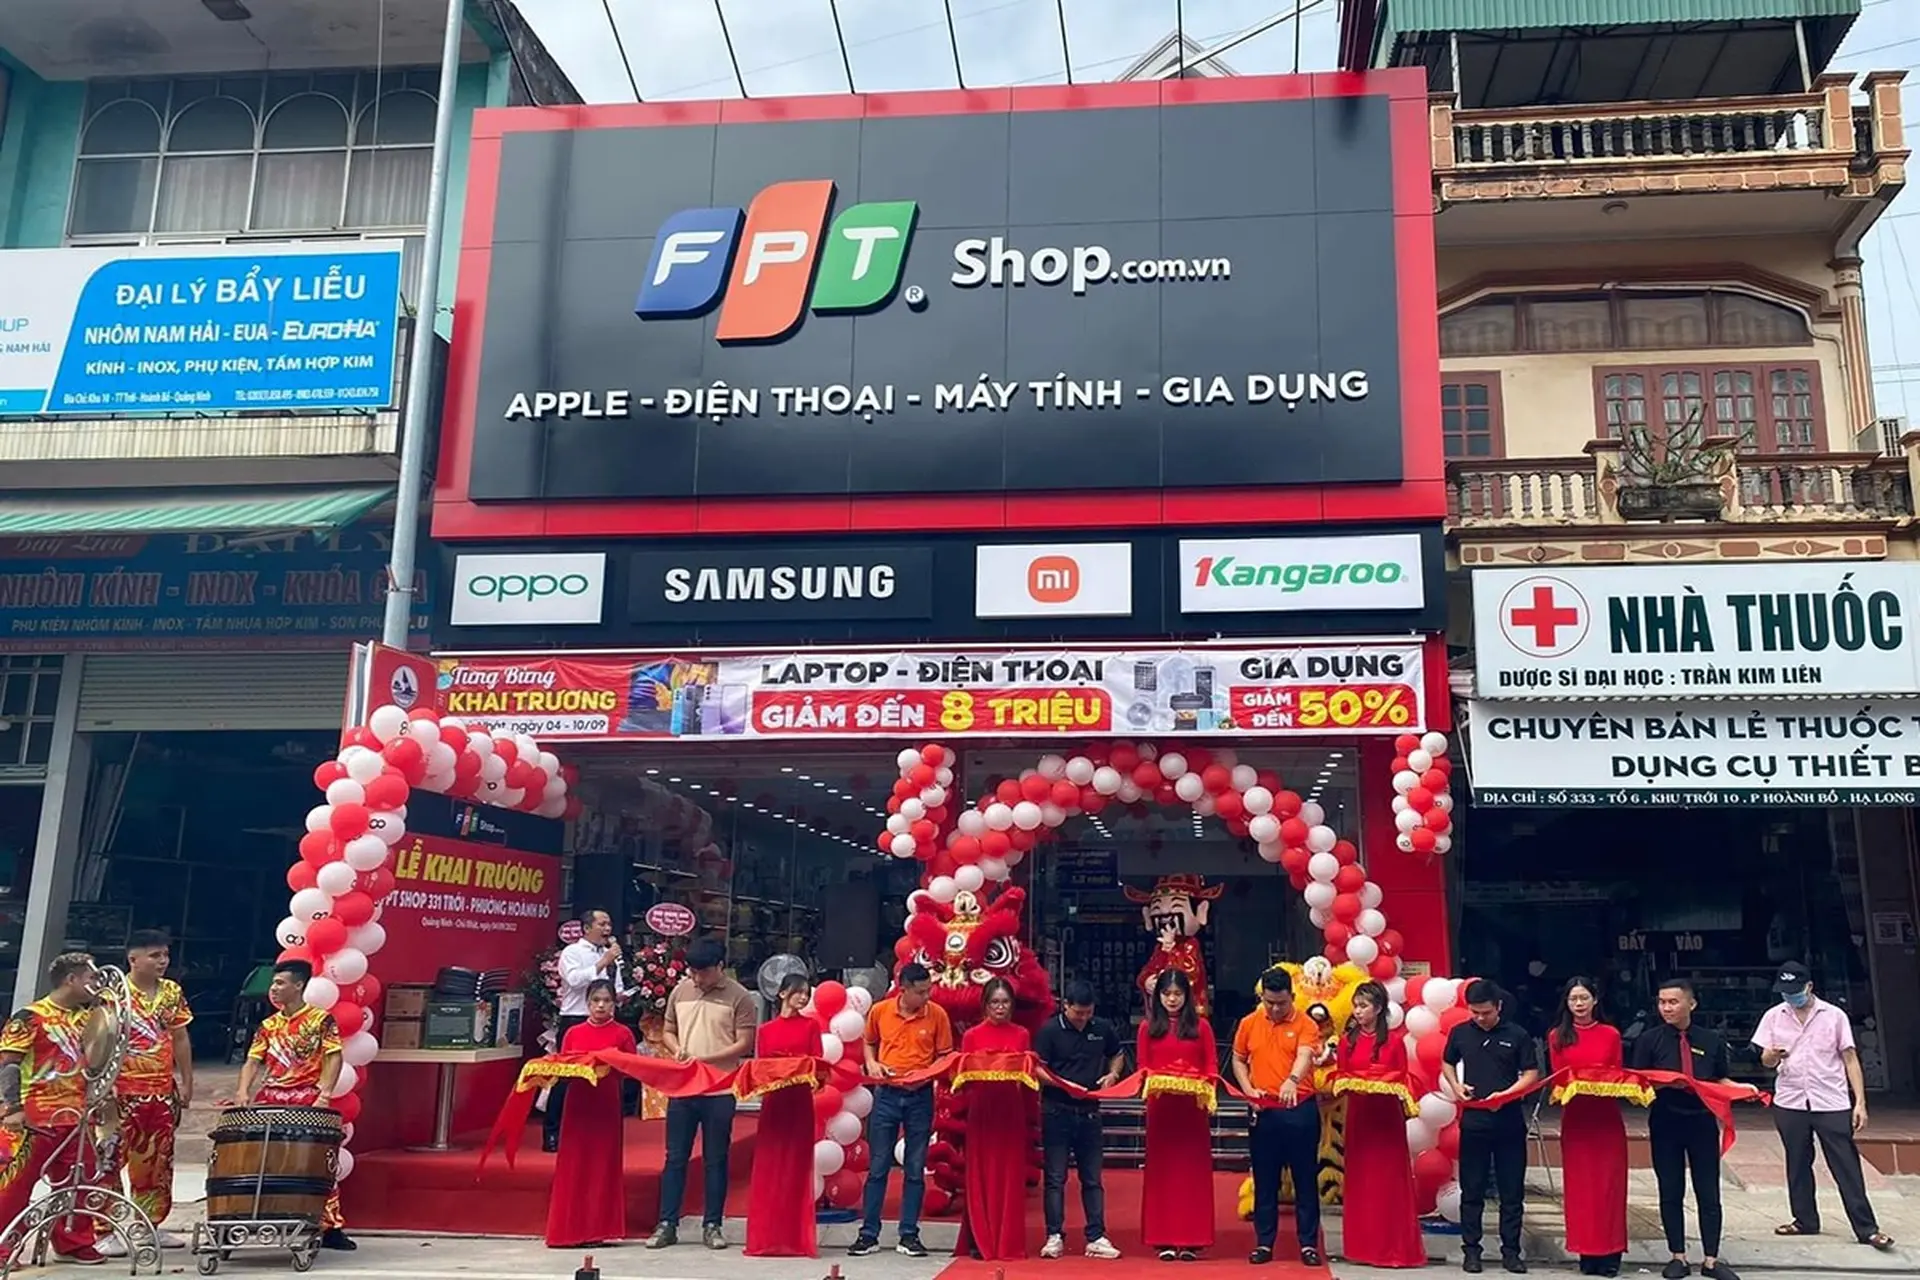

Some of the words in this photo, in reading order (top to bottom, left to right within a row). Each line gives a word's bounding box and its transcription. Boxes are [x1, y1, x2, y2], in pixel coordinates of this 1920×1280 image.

[951, 236, 1231, 295] Shop.com.vn
[115, 284, 162, 309] ĐẠI
[171, 277, 207, 304] LÝ
[216, 265, 283, 303] BẨY
[293, 264, 366, 300] LIỄU
[0, 318, 29, 332] UP
[84, 323, 140, 345] NHÔM
[144, 325, 186, 343] NAM
[188, 319, 220, 342] HẢI
[233, 323, 269, 341] EUA
[85, 360, 125, 375] KÍNH
[136, 360, 181, 375] INOX,
[184, 359, 219, 376] PHỤ
[221, 356, 263, 375] KIỆN,
[305, 355, 340, 373] HỢP
[343, 354, 374, 369] KIM
[504, 389, 629, 419] APPLE
[664, 380, 758, 422] ĐIỆN
[771, 384, 894, 421] THOẠI
[934, 373, 1018, 411] MÁY
[1028, 372, 1122, 407] TÍNH
[1162, 376, 1235, 404] GIA
[1247, 371, 1369, 409] DỤNG
[0, 566, 85, 608] NHÔM
[88, 566, 162, 607] KÍNH
[185, 571, 259, 607] INOX
[281, 562, 361, 607] KHÓA
[469, 574, 589, 602] oppo
[664, 565, 896, 602] SAMSUNG
[152, 617, 184, 631] INOX
[1607, 584, 1715, 653] NHÀ
[1726, 571, 1902, 652] THUỐC
[761, 661, 889, 684] LAPTOP
[917, 655, 993, 688] ĐIỆN
[1002, 659, 1103, 686] THOẠI
[1240, 657, 1299, 680] GIA
[1307, 654, 1404, 683] DỤNG
[1499, 667, 1553, 688] DƯỢC
[1585, 668, 1618, 690] ĐẠI
[1623, 667, 1664, 689] HỌC
[1738, 667, 1777, 685] KIM
[1782, 663, 1823, 684] LIÊN
[449, 691, 508, 712] KHAI
[513, 688, 617, 712] TRƯƠNG
[761, 696, 847, 728] GIẢM
[855, 694, 925, 728] ĐẾN
[940, 690, 975, 731] 8
[988, 690, 1102, 732] TRIỆU
[1243, 688, 1292, 707] GIẢM
[1297, 689, 1409, 726] 50%
[511, 719, 546, 736] ngày
[546, 719, 561, 731] 04
[572, 718, 606, 731] 10/09
[1251, 709, 1293, 727] ĐẾN
[1487, 711, 1635, 740] CHUYÊN
[1644, 711, 1718, 740] BÁN
[1727, 709, 1768, 739] LẺ
[1775, 705, 1904, 739] THUỐC
[1611, 755, 1718, 784] DỤNG
[1726, 755, 1778, 784] CỤ
[1787, 743, 1893, 778] THIẾT
[1483, 792, 1509, 806] ĐỊA
[1570, 793, 1596, 805] 333
[1627, 793, 1640, 804] 6
[1651, 793, 1681, 804] KHU
[1723, 793, 1740, 804] 10
[1750, 793, 1760, 804] P
[1763, 790, 1815, 804] HOÀNH
[1850, 793, 1874, 806] HẠ
[1875, 793, 1915, 804] LONG
[395, 838, 424, 880] LỄ
[422, 853, 473, 886] KHAI
[474, 859, 545, 894] TRƯƠNG
[399, 890, 427, 909] SHOP
